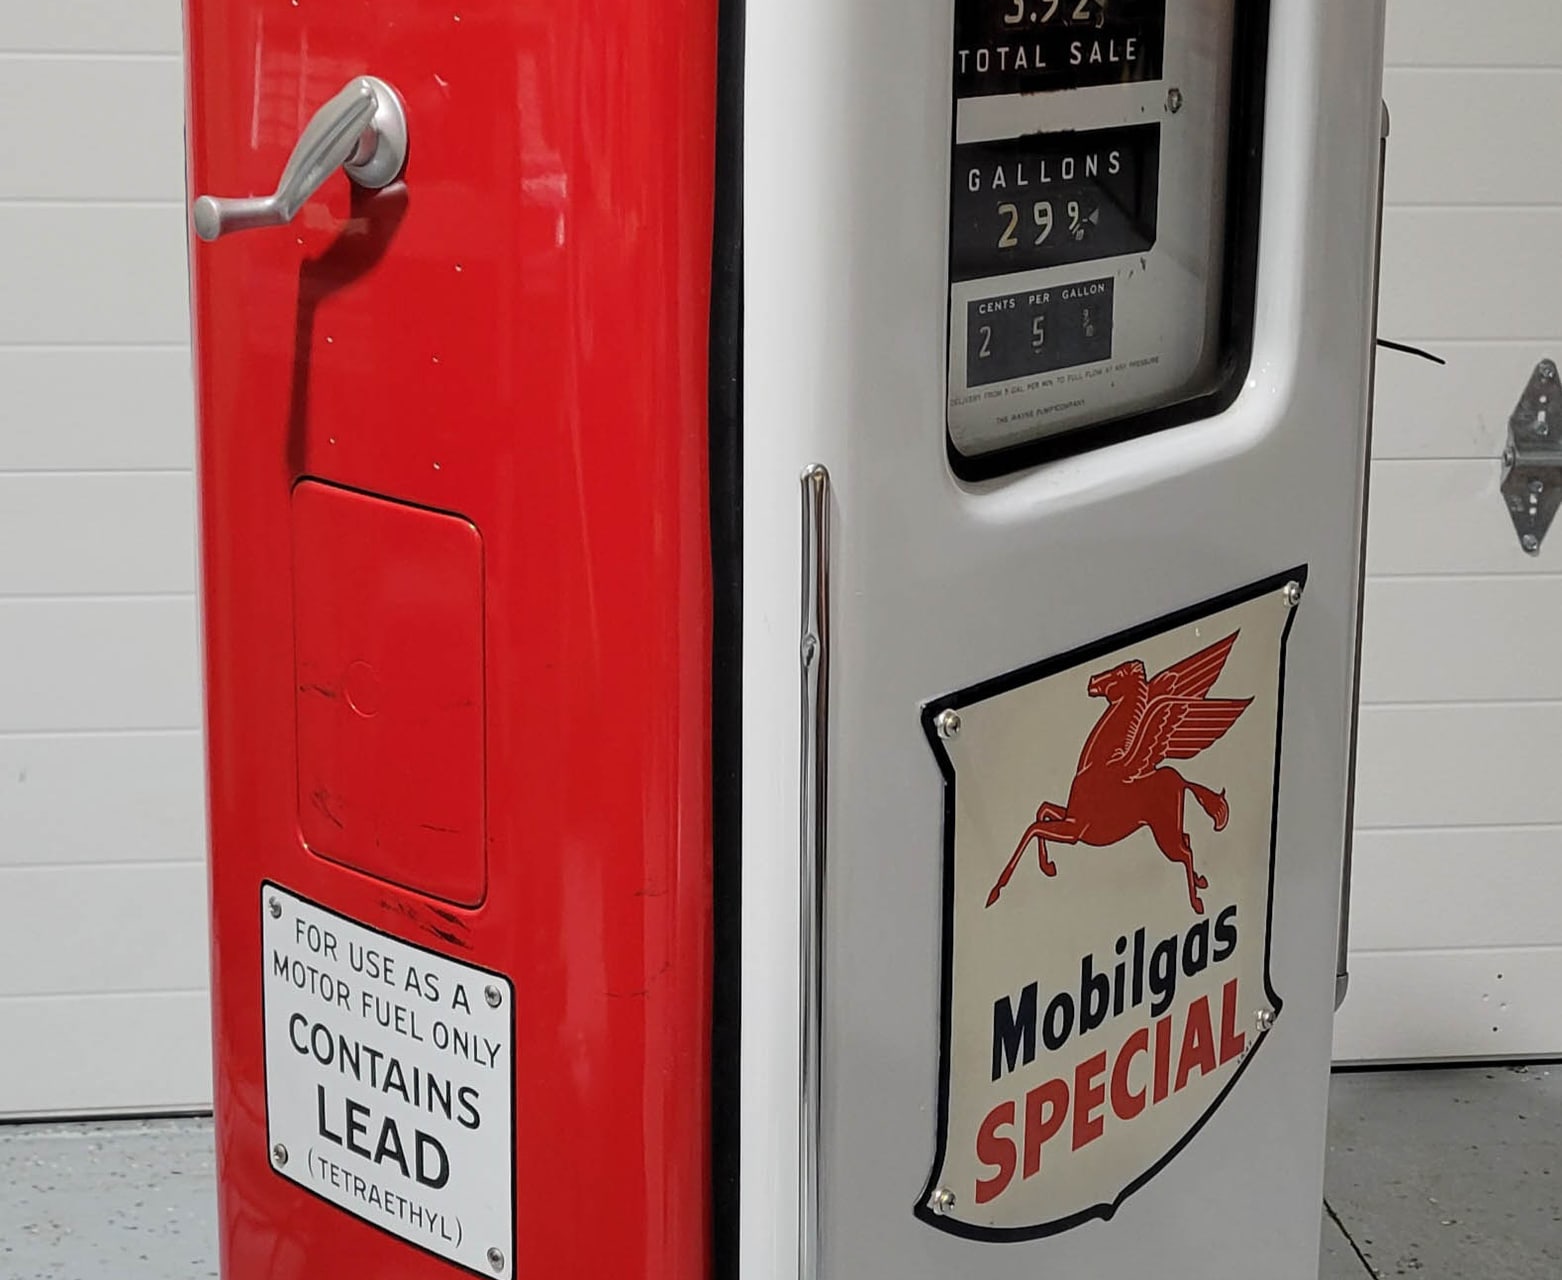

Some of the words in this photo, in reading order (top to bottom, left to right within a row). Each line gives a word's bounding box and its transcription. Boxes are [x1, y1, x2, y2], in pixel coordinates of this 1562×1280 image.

[959, 44, 1046, 74] TOTAL
[1070, 38, 1137, 65] SALE
[969, 151, 1120, 192] GALLONS
[979, 298, 1016, 314] CENTS
[1028, 292, 1050, 305] PER
[1061, 283, 1106, 300] GALLON
[273, 949, 352, 1012] MOTOR
[362, 991, 424, 1042] FUEL
[432, 1021, 502, 1070] ONLY
[295, 918, 338, 962] FOR
[349, 942, 396, 986] USE
[404, 966, 440, 1003] AS
[451, 984, 471, 1015] A
[991, 905, 1238, 1082] Mobilgas
[288, 1013, 481, 1131] CONTAINS
[975, 978, 1247, 1205] SPECIAL
[317, 1084, 450, 1190] LEAD
[307, 1146, 464, 1248] (TETRAETHYL)
